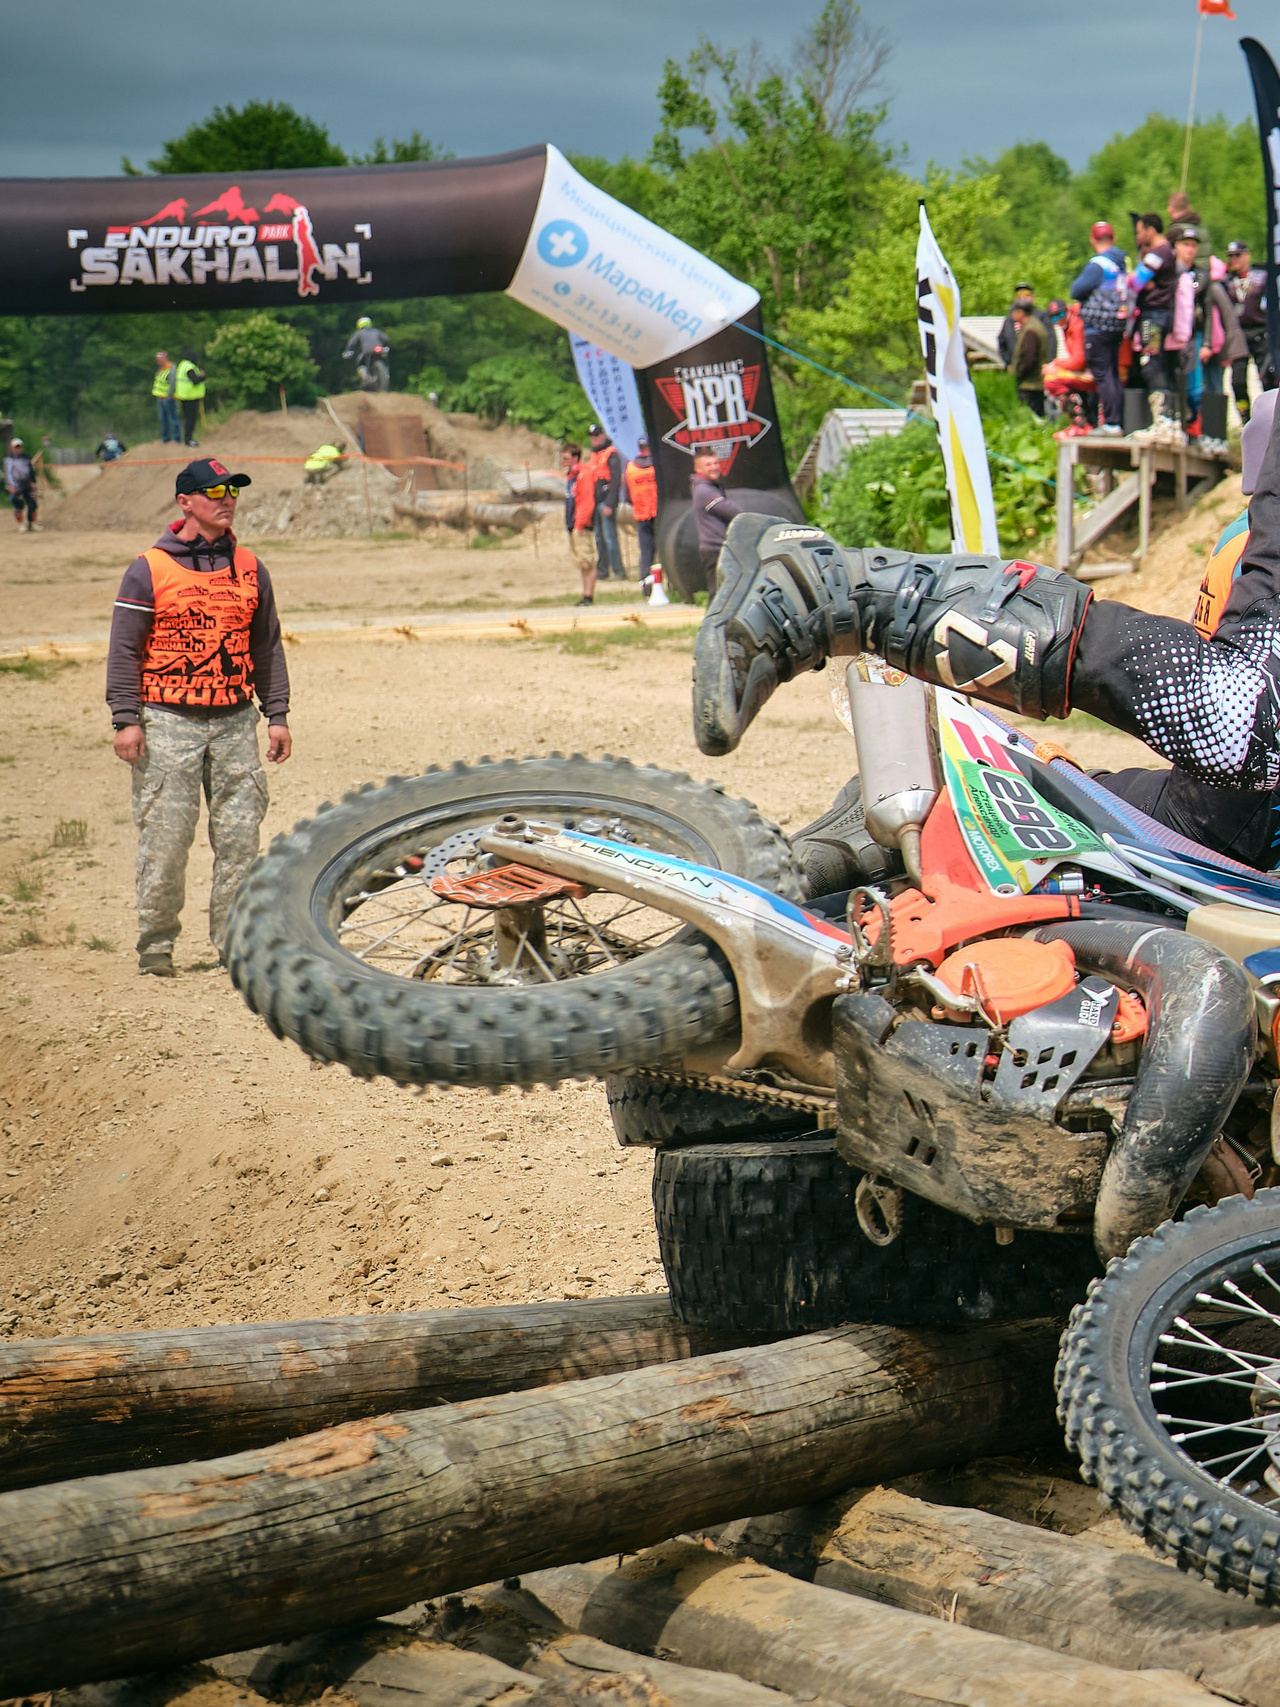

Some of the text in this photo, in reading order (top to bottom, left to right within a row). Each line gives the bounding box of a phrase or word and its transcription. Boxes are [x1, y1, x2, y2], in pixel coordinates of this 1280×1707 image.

[105, 226, 291, 248] ENDURO PARK
[560, 180, 678, 267] Медицинский
[574, 293, 643, 341] 31-13-13
[586, 252, 704, 339] МареМед
[143, 672, 229, 689] ENDURO
[981, 770, 1075, 850] 292
[968, 830, 1003, 873] MOTOREX
[1078, 999, 1091, 1026] GUIDE
[1088, 1000, 1101, 1027] HARD
